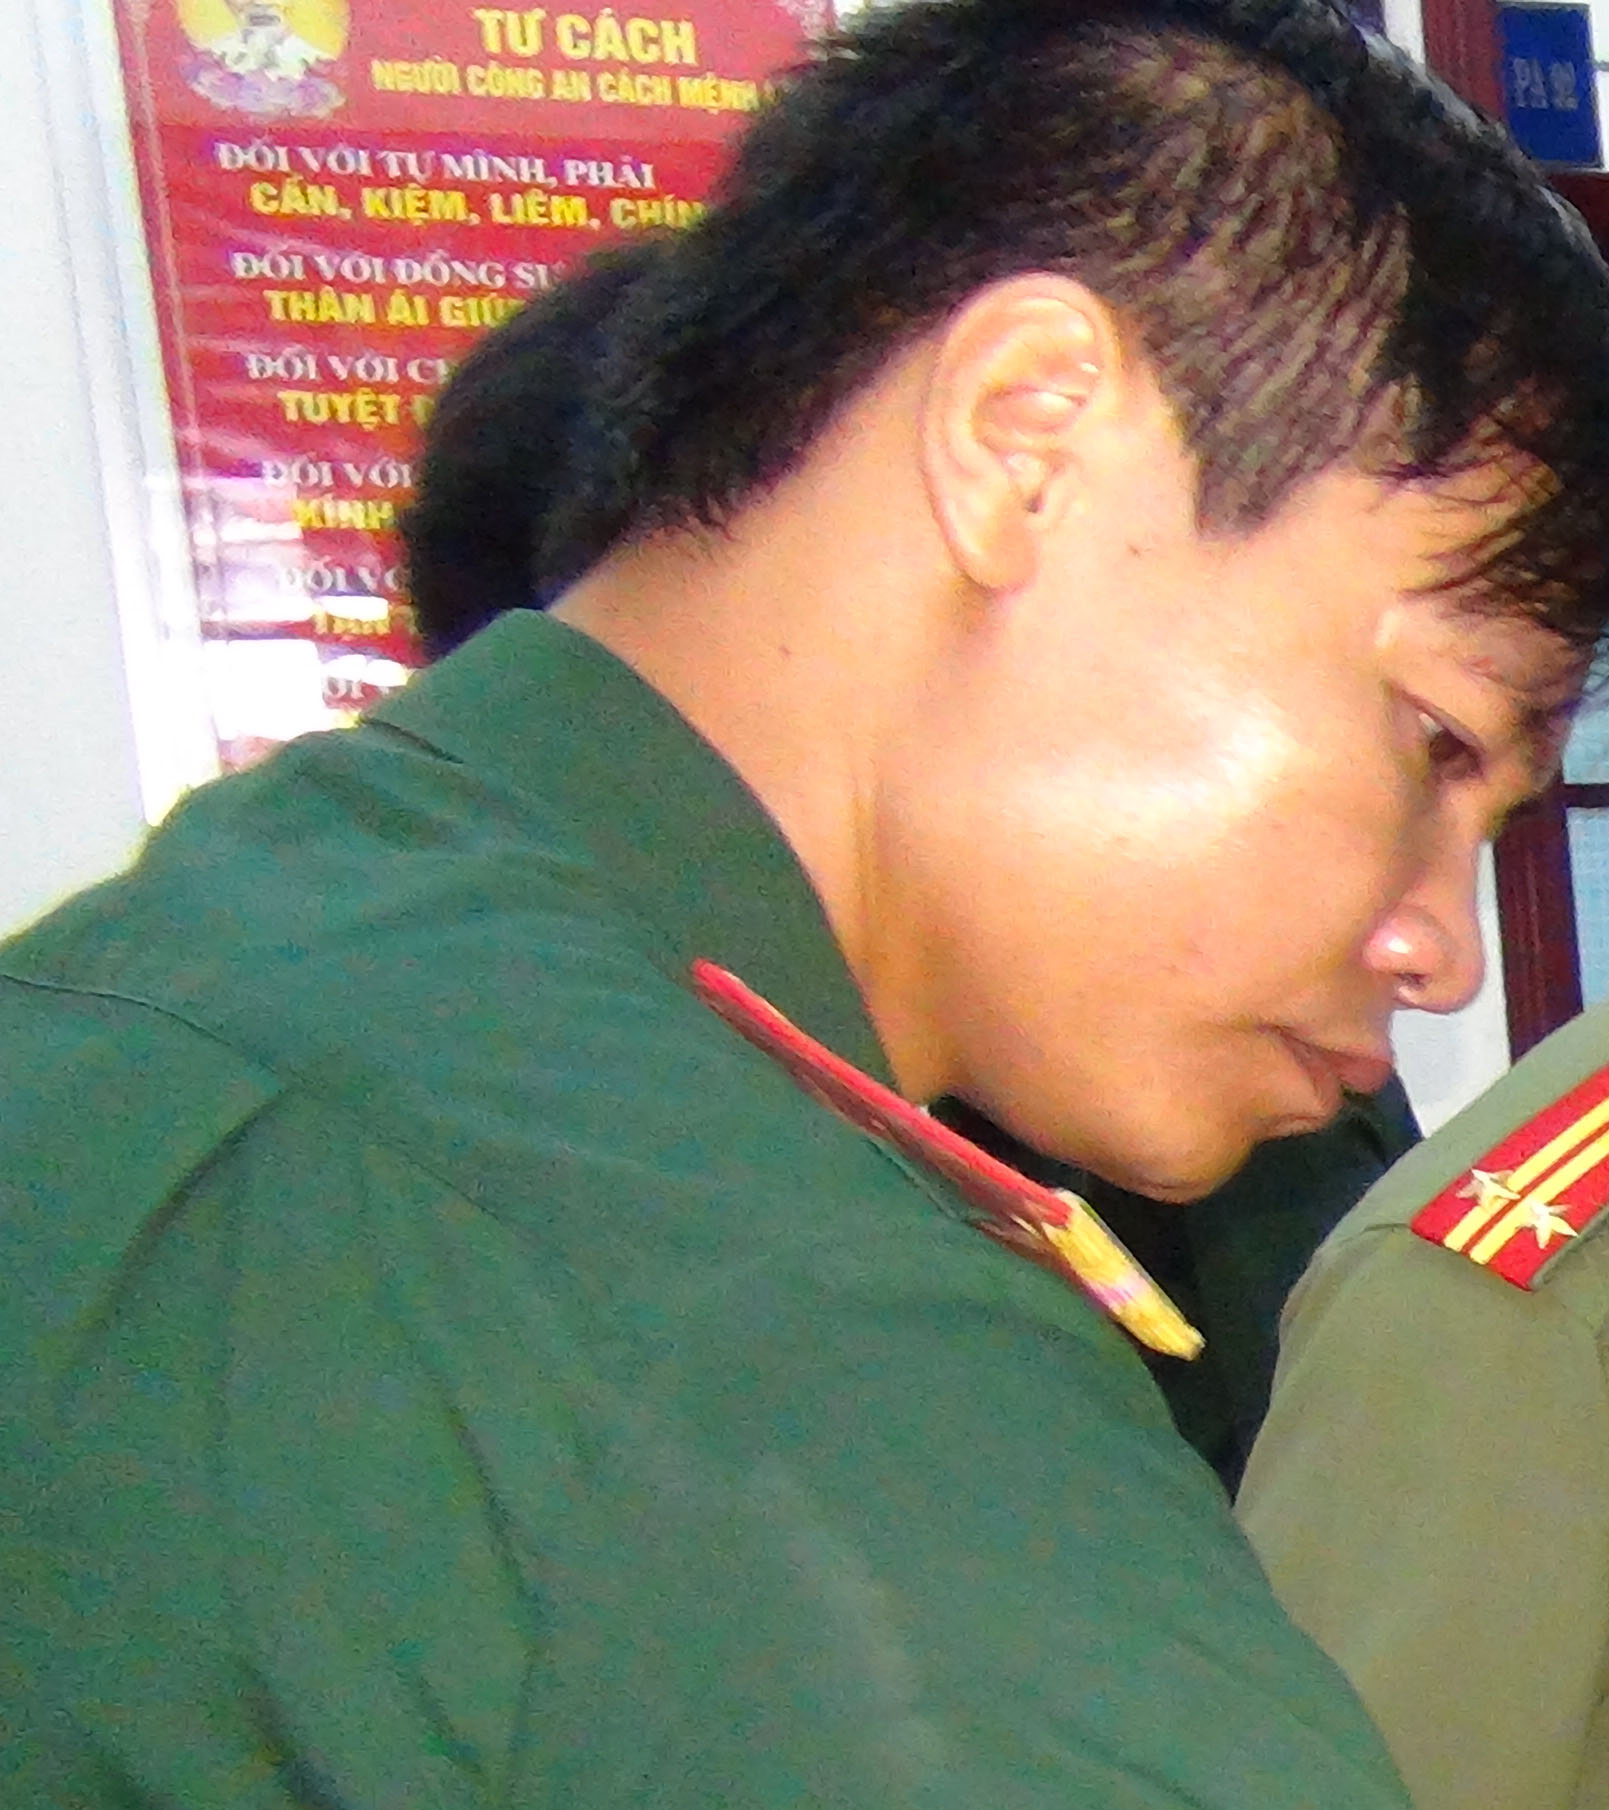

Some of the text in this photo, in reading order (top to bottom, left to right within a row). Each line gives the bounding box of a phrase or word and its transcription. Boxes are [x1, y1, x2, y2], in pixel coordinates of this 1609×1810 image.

[556, 8, 698, 66] CÁCH
[550, 69, 593, 101] AN
[263, 285, 376, 324] THÂN
[277, 387, 400, 432] TUYỆT
